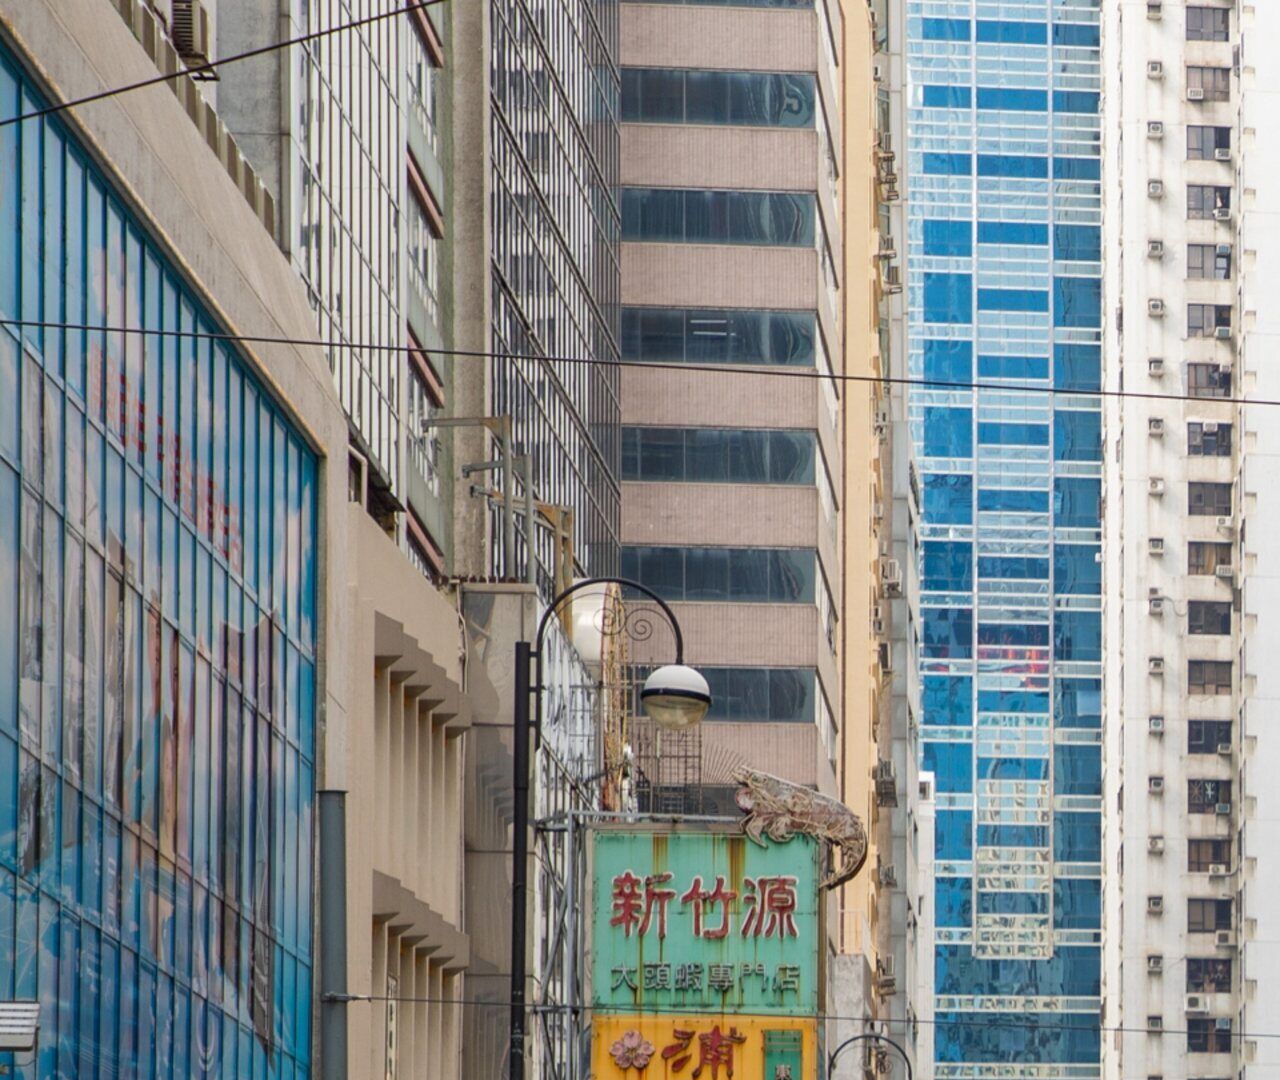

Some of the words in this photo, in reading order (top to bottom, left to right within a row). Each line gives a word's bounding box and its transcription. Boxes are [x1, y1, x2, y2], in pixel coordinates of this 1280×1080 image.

[609, 868, 800, 941] 新竹源
[609, 962, 801, 993] 大頭蝦專門店
